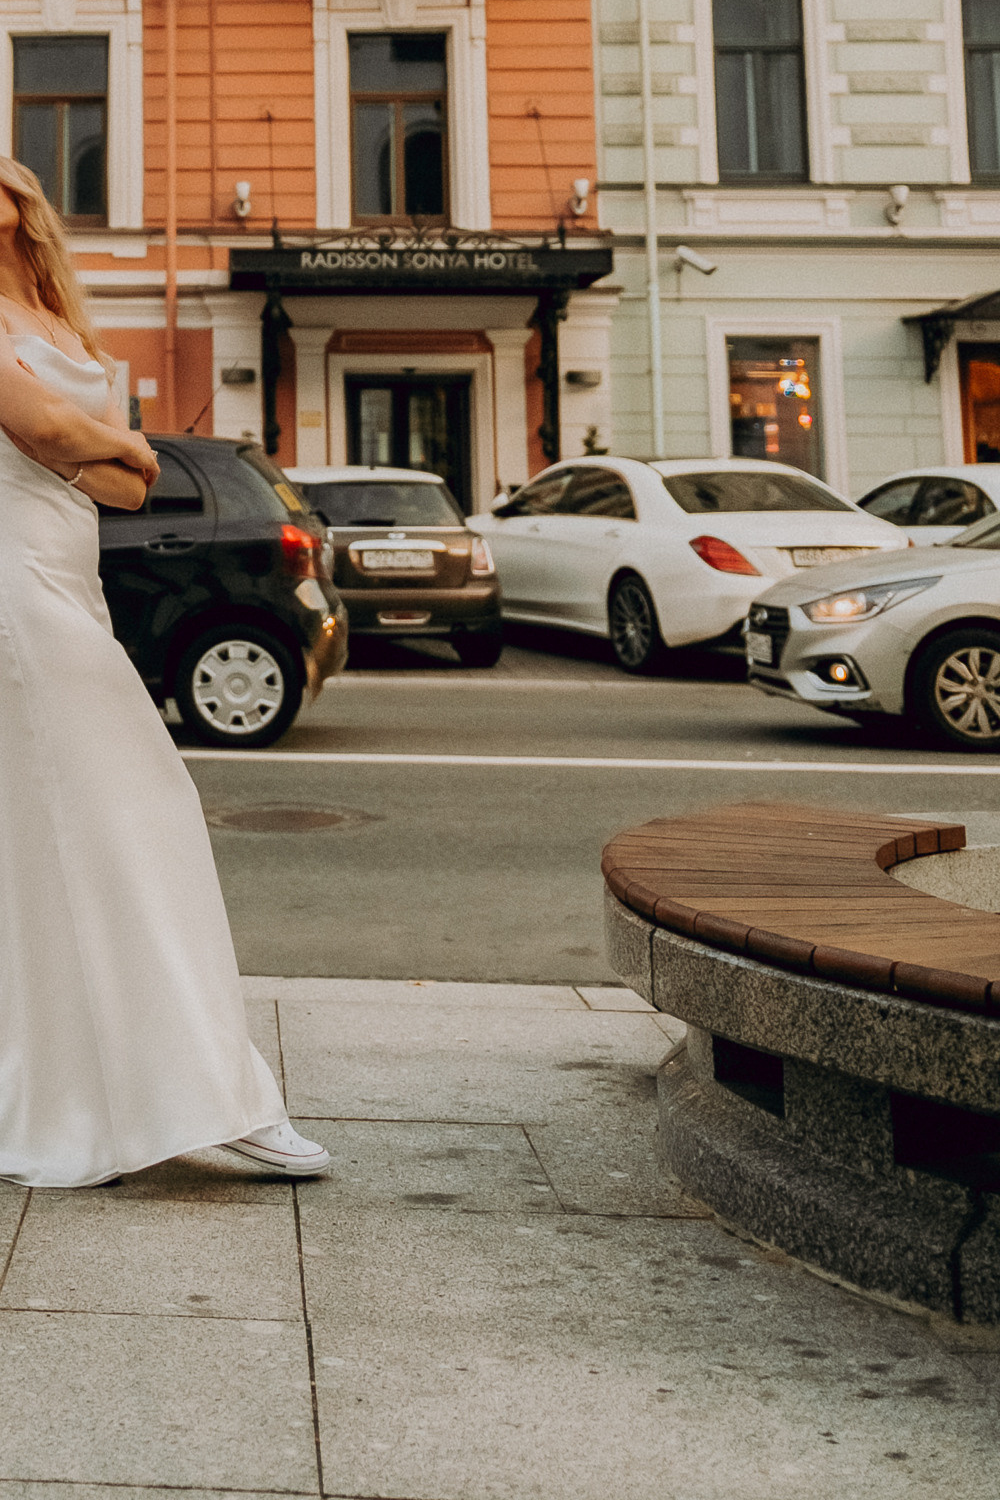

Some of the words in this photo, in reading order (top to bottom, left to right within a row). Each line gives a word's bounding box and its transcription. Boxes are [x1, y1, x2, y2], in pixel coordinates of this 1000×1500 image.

[300, 251, 398, 270] RADISSON
[402, 252, 470, 270] SONYA
[473, 252, 539, 270] HOTEL
